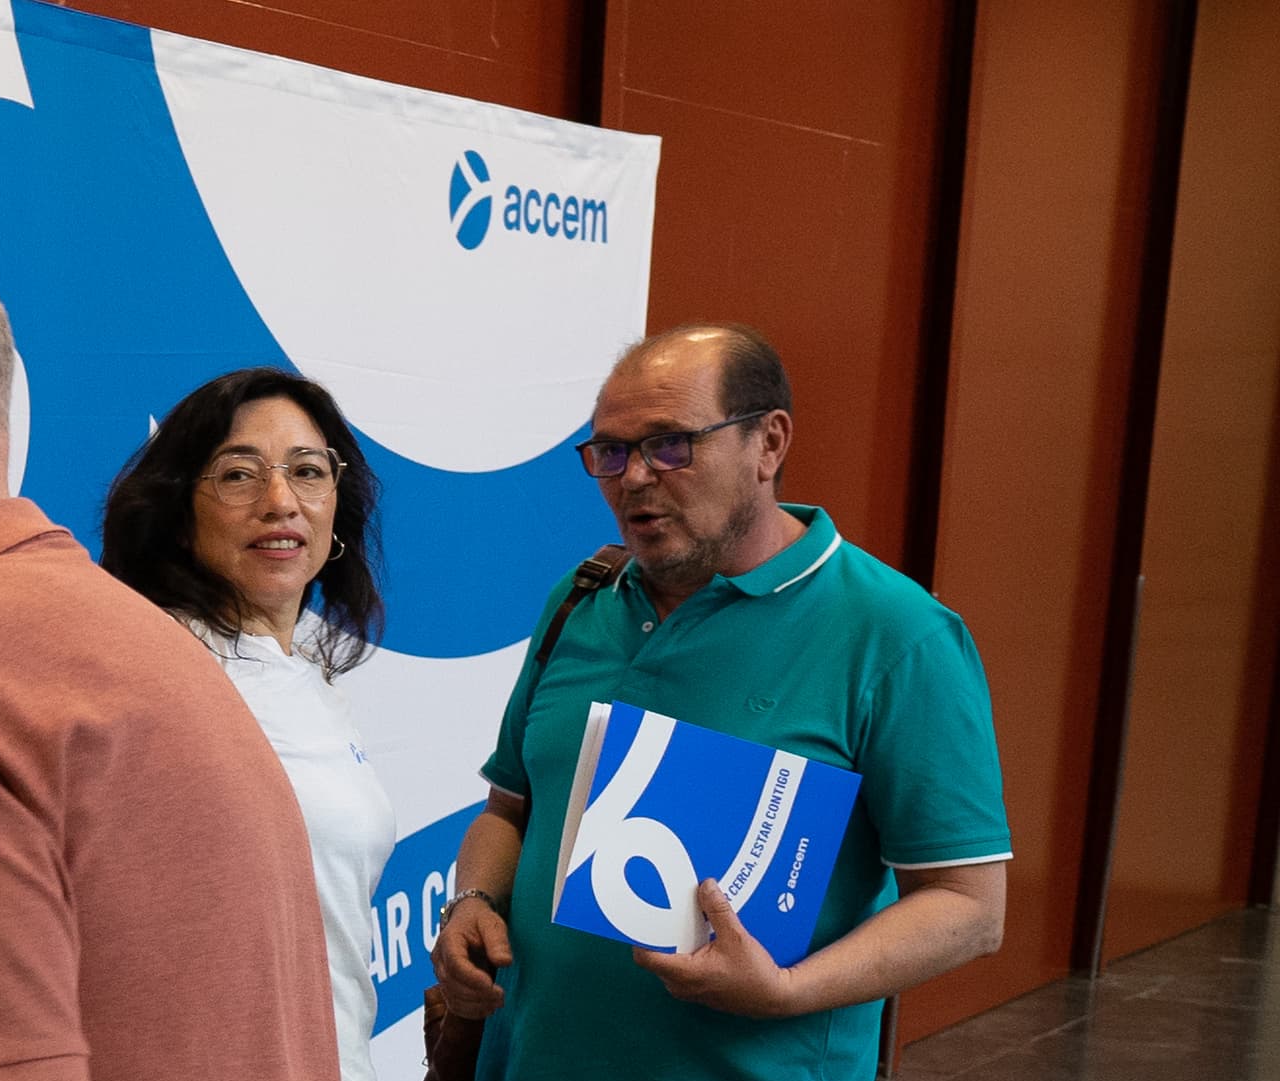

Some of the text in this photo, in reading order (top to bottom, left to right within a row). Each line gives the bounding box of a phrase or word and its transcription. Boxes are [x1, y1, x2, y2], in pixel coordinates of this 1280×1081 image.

[504, 185, 607, 243] accem
[728, 861, 758, 896] CERCA,
[750, 821, 773, 858] ESTAR
[766, 768, 790, 820] CONTIGO
[787, 837, 810, 889] accem
